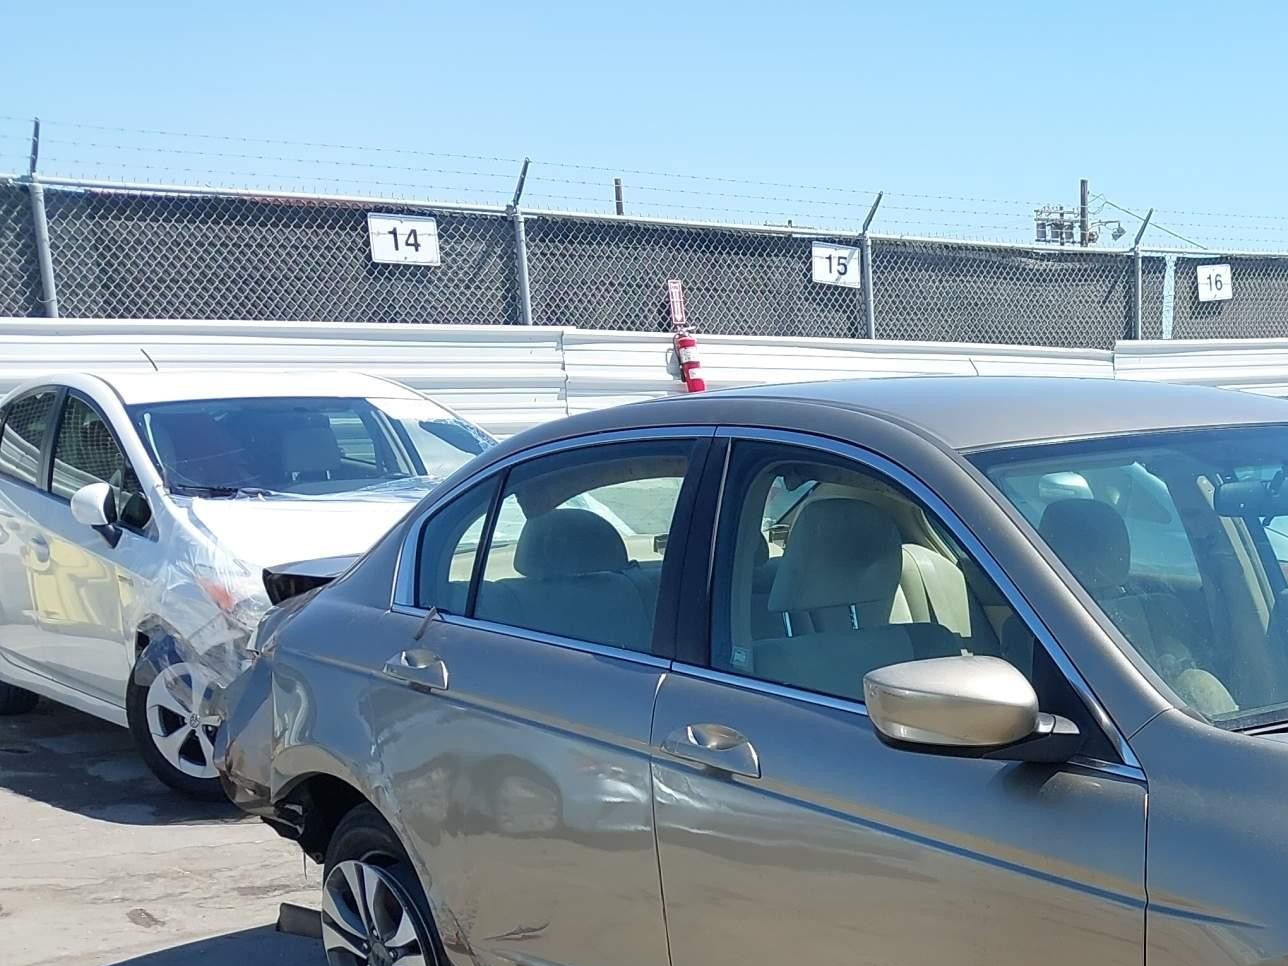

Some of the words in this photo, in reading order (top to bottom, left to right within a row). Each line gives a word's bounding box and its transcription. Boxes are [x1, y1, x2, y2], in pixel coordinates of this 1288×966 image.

[387, 226, 421, 252] 14
[824, 253, 848, 276] 15
[1206, 273, 1223, 292] 16
